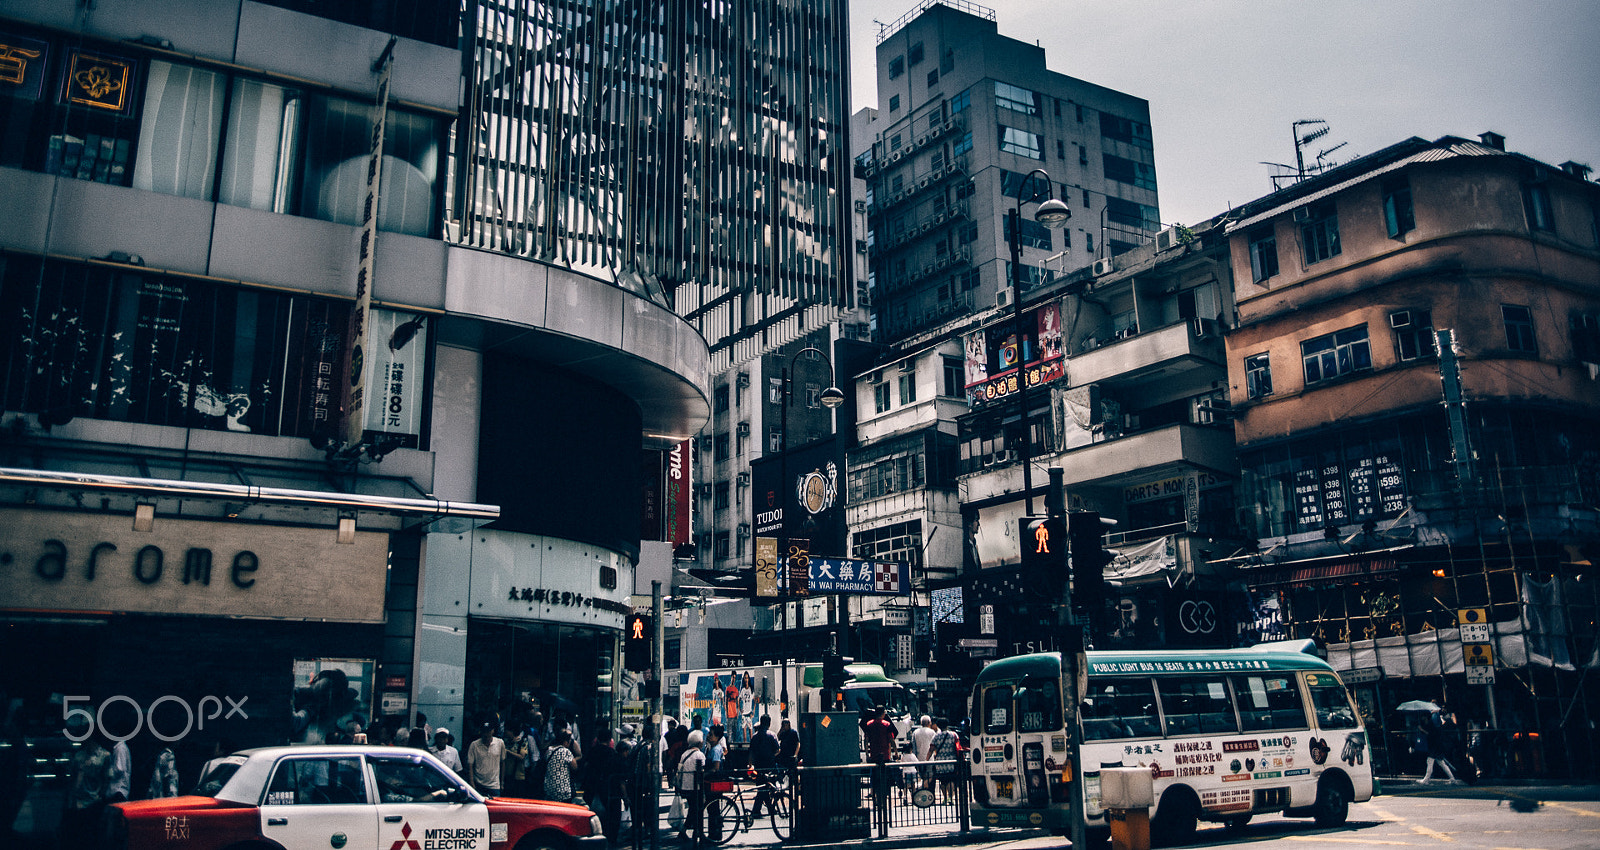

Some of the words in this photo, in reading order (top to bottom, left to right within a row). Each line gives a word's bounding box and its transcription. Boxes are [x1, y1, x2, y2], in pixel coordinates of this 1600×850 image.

[1125, 483, 1160, 502] DARTS
[1164, 473, 1217, 494] MOMTS
[1324, 480, 1340, 488] $398
[1326, 490, 1341, 500] $208
[789, 545, 810, 568] 25
[33, 538, 259, 589] arome
[756, 558, 776, 580] 25
[819, 582, 832, 590] WAI
[836, 582, 874, 591] PHARMACY
[1236, 611, 1283, 634] Purple
[1092, 662, 1118, 672] PUBLIC
[1118, 662, 1138, 672] LIGHT
[1140, 662, 1154, 671] BUS
[1164, 662, 1184, 671] SEATS
[166, 816, 190, 828] 的士
[165, 826, 190, 840] TAXI
[425, 829, 485, 839] MITSUBISHI
[425, 840, 476, 849] ELECTRIC
